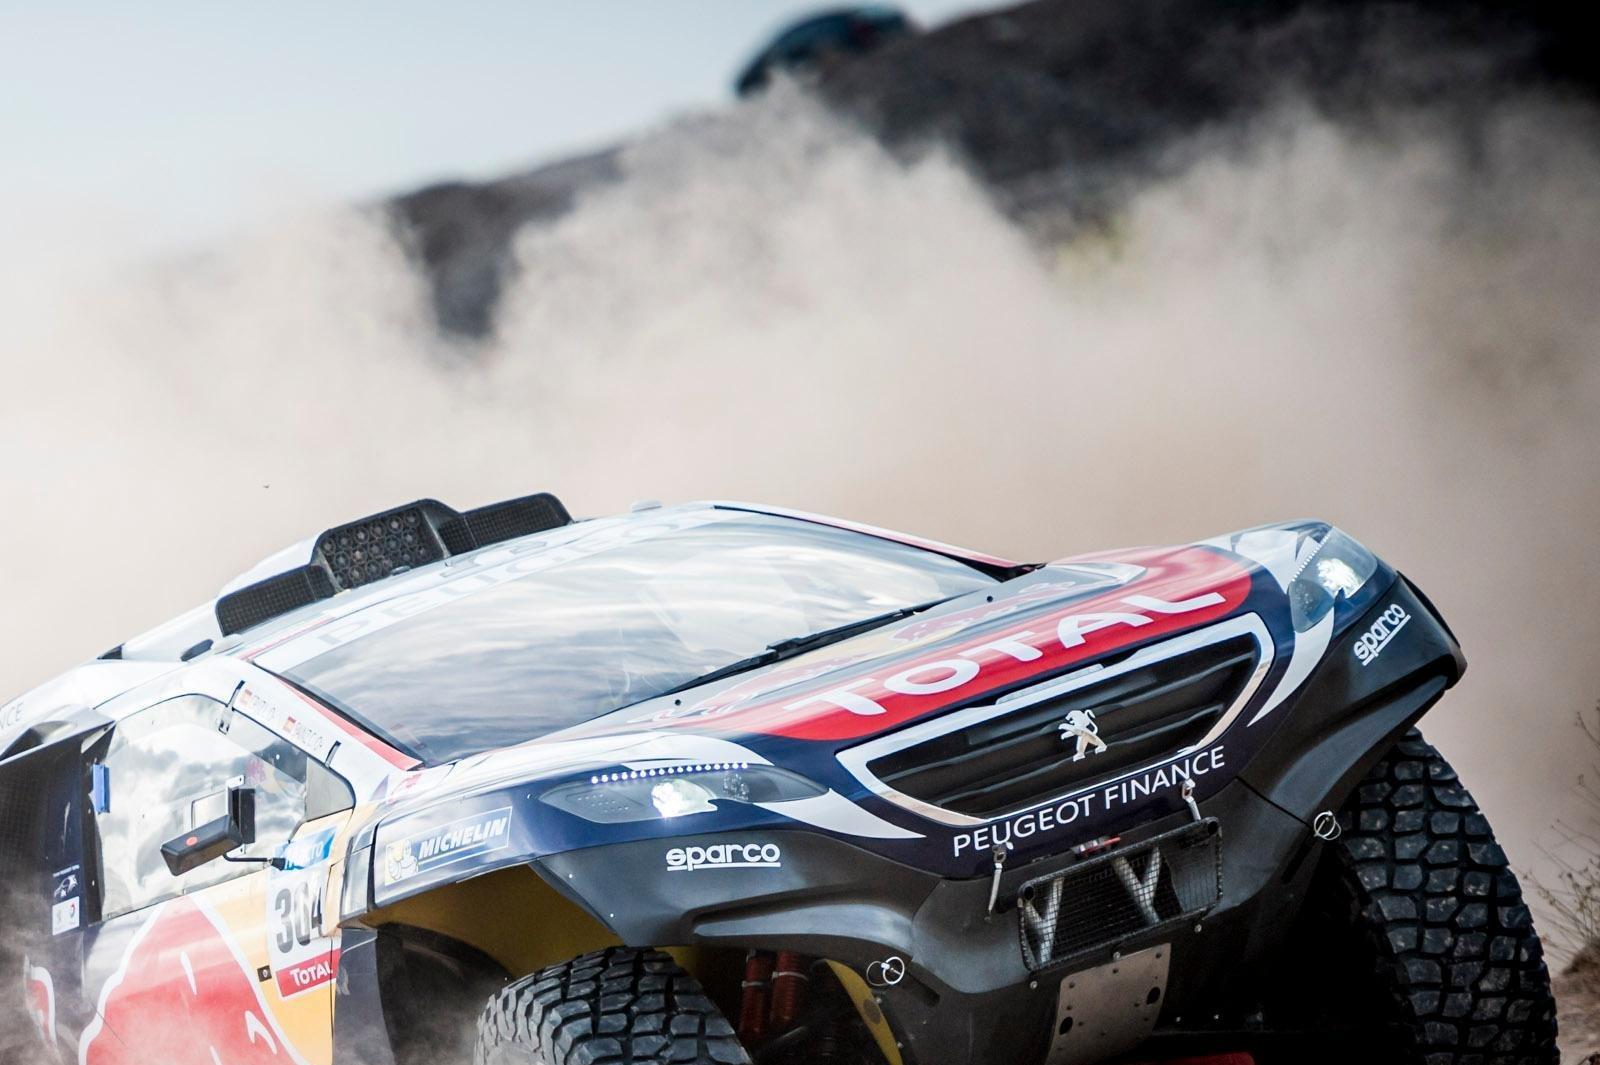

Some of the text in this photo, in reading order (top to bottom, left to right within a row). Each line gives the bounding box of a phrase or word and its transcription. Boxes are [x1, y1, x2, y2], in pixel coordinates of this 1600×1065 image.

[782, 592, 1226, 716] TOTAL
[1353, 603, 1410, 664] sparco
[953, 745, 1226, 857] PEUGEOT FINANCE
[418, 816, 508, 860] MICHELIN
[665, 843, 781, 872] sparco
[275, 873, 323, 954] 304
[289, 960, 334, 987] TOTAL
